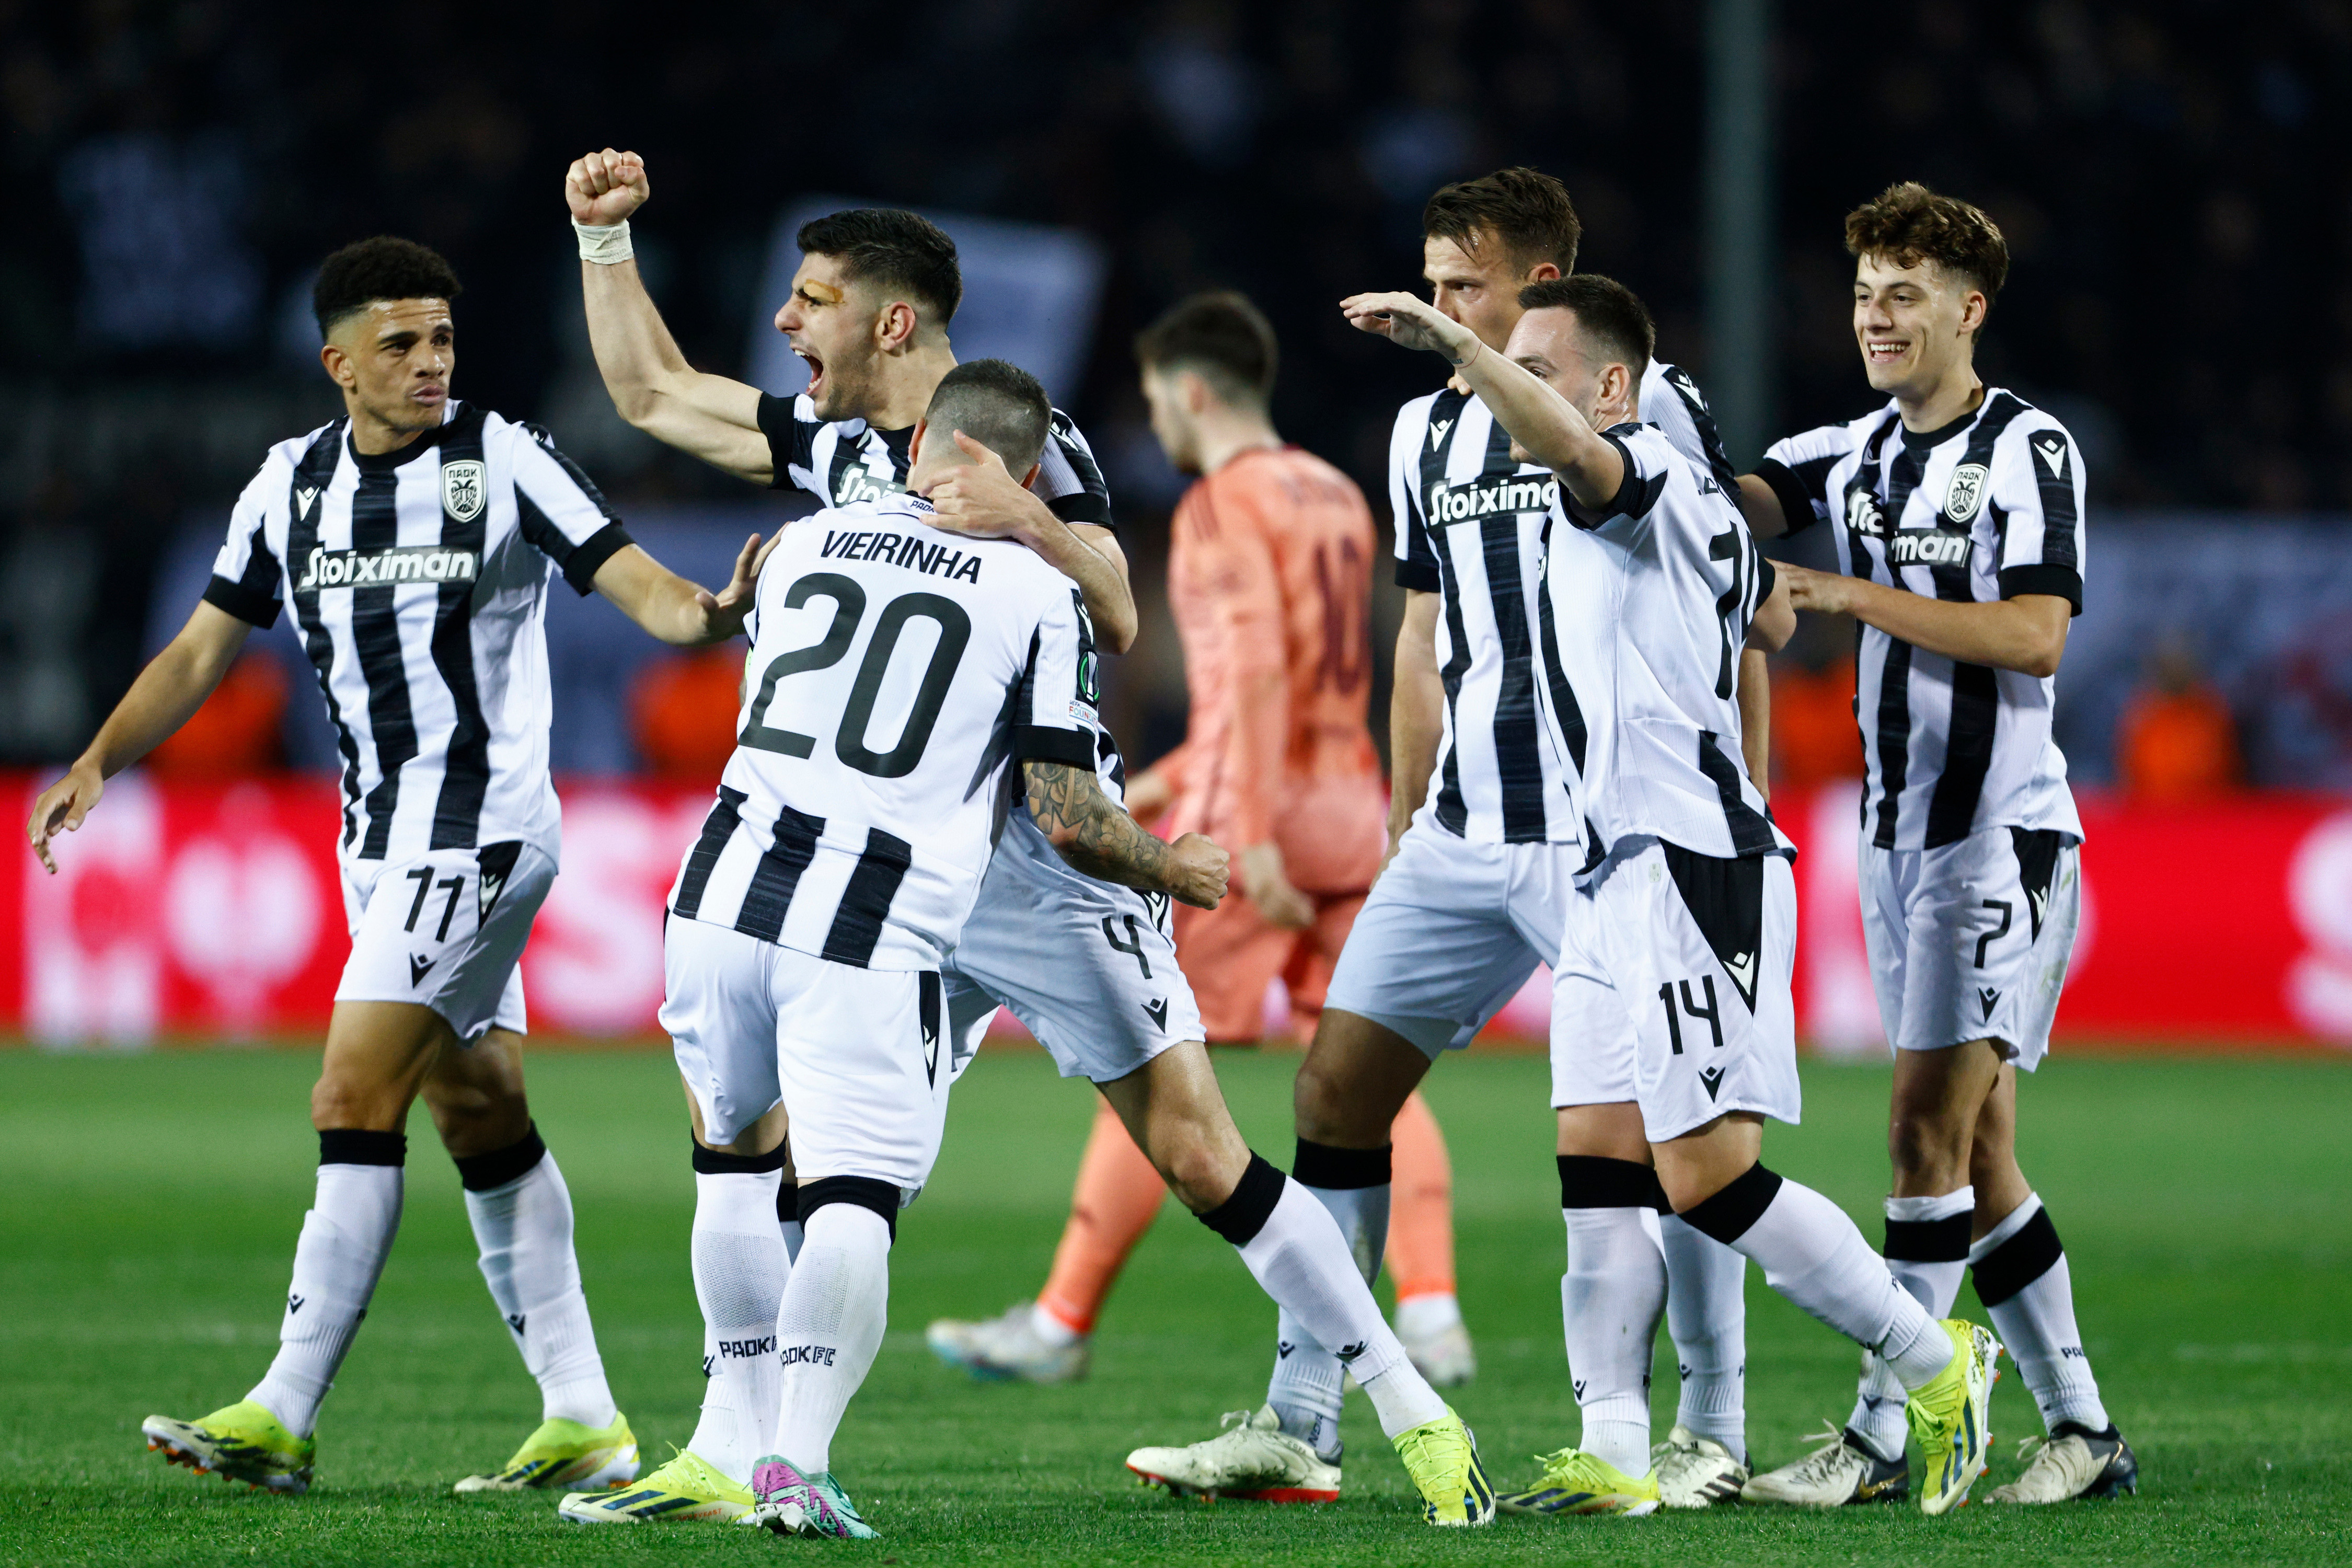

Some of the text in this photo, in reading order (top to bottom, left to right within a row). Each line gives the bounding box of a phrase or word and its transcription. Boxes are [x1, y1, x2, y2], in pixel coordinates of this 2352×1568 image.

[1429, 479, 1555, 526] Stoixima
[301, 547, 474, 587] Stoiximan
[821, 531, 983, 585] VIERINHA
[737, 572, 972, 779] 20
[1102, 914, 1152, 979] 4
[1658, 974, 1724, 1055] 14
[719, 1336, 770, 1358] PAOK
[780, 1345, 836, 1369] AOK FC
